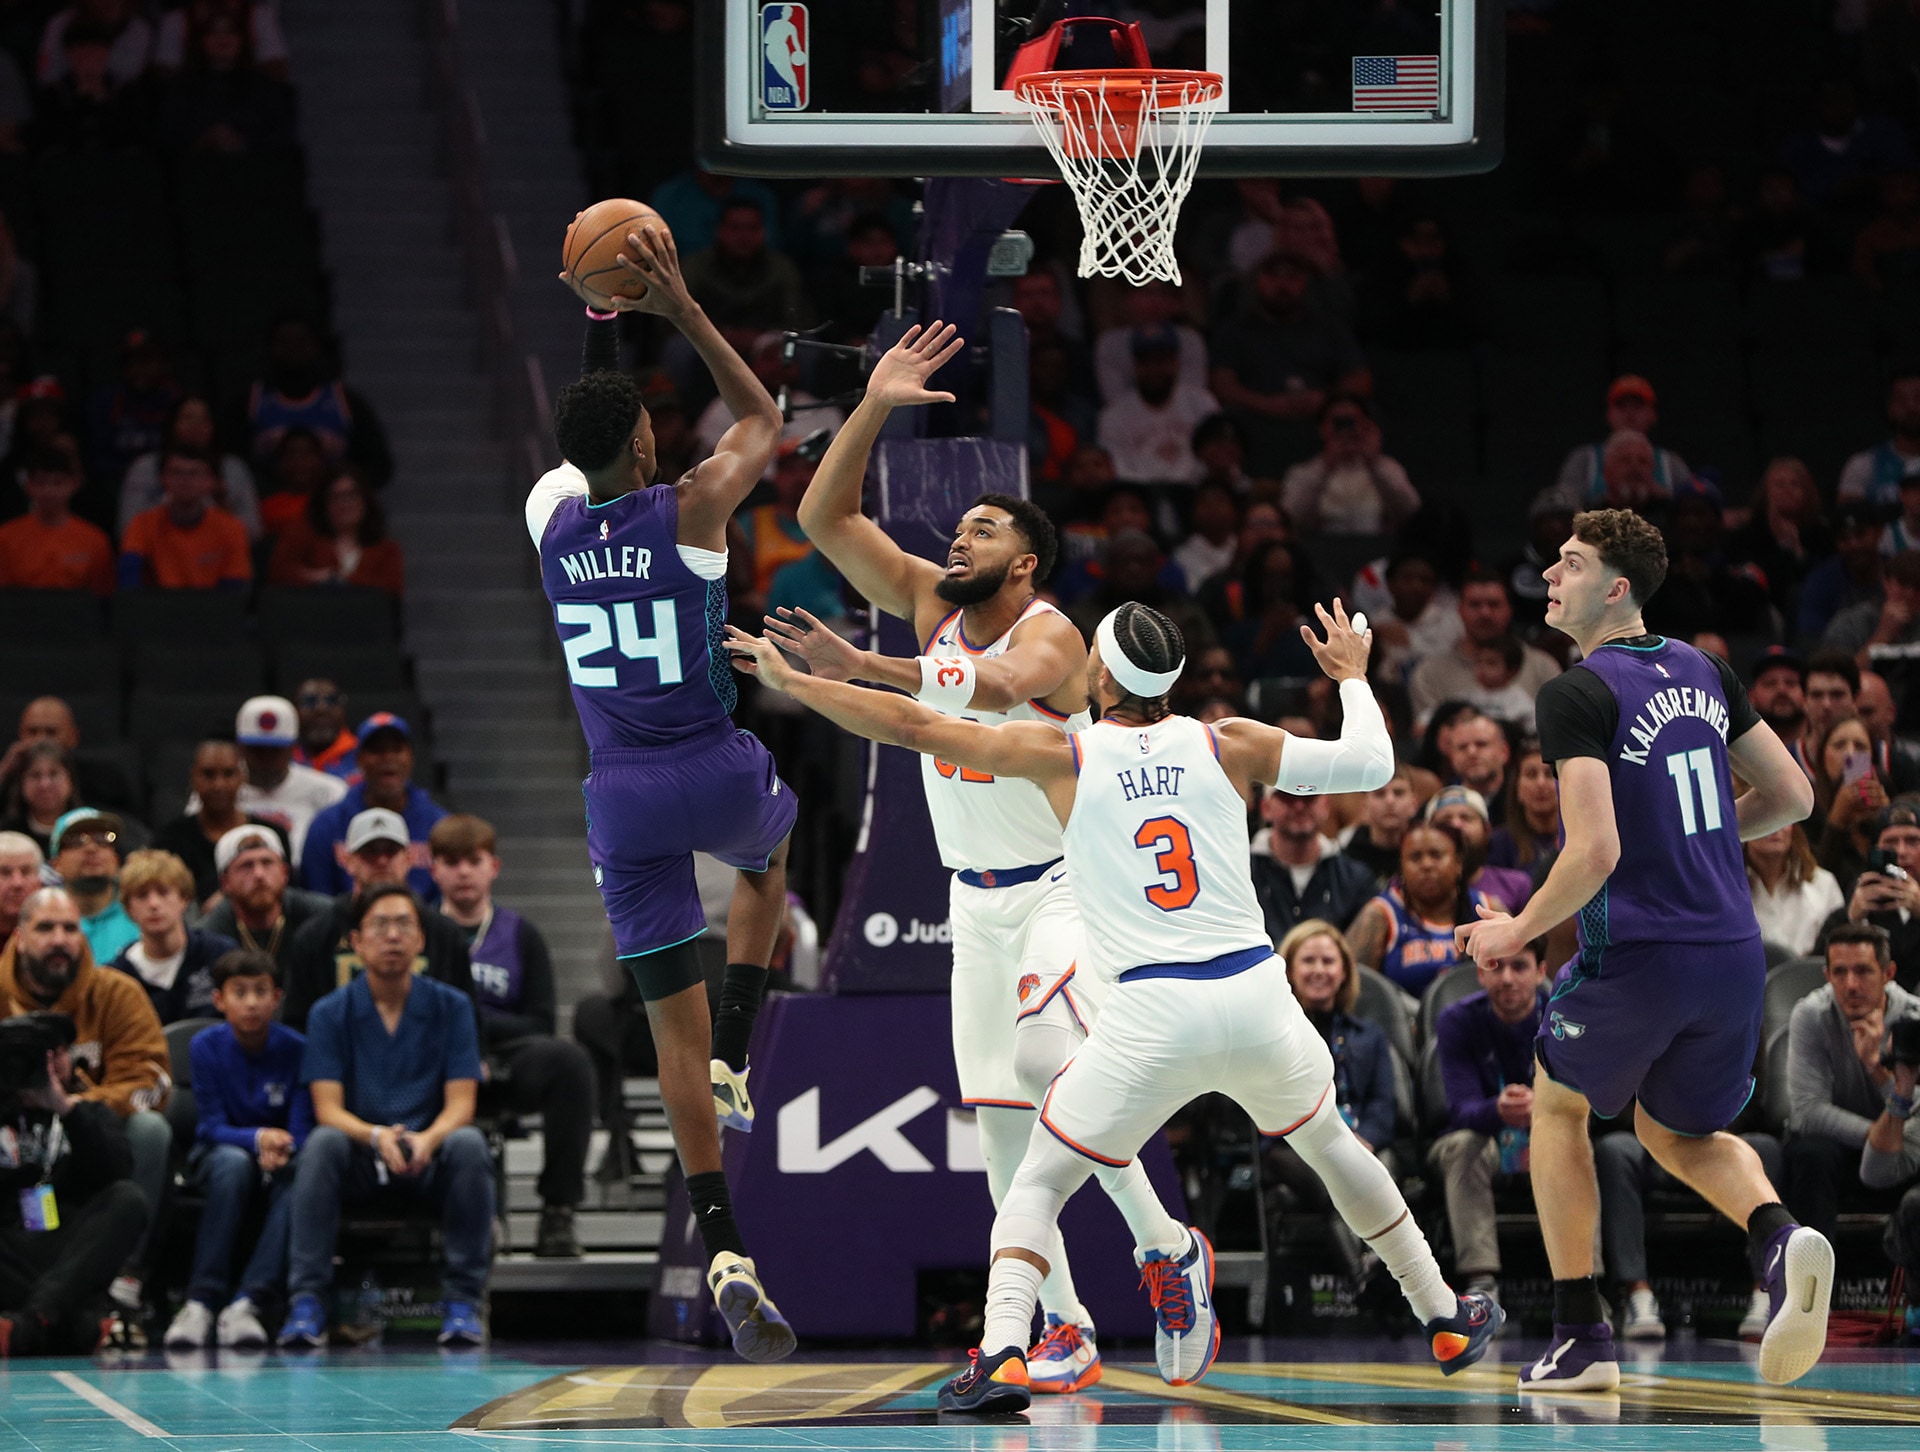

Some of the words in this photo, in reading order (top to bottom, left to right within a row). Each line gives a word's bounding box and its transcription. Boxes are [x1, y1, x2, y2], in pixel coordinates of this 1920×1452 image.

[768, 86, 791, 103] NBA
[558, 546, 652, 585] MILLER
[556, 598, 684, 688] 24
[1619, 686, 1731, 767] KALKBRENNER
[1117, 766, 1185, 802] HART
[1666, 746, 1723, 836] 11
[1133, 815, 1201, 912] 3
[901, 917, 952, 944] Jud
[777, 1085, 988, 1174] KI
[1840, 1278, 1887, 1293] ILITY
